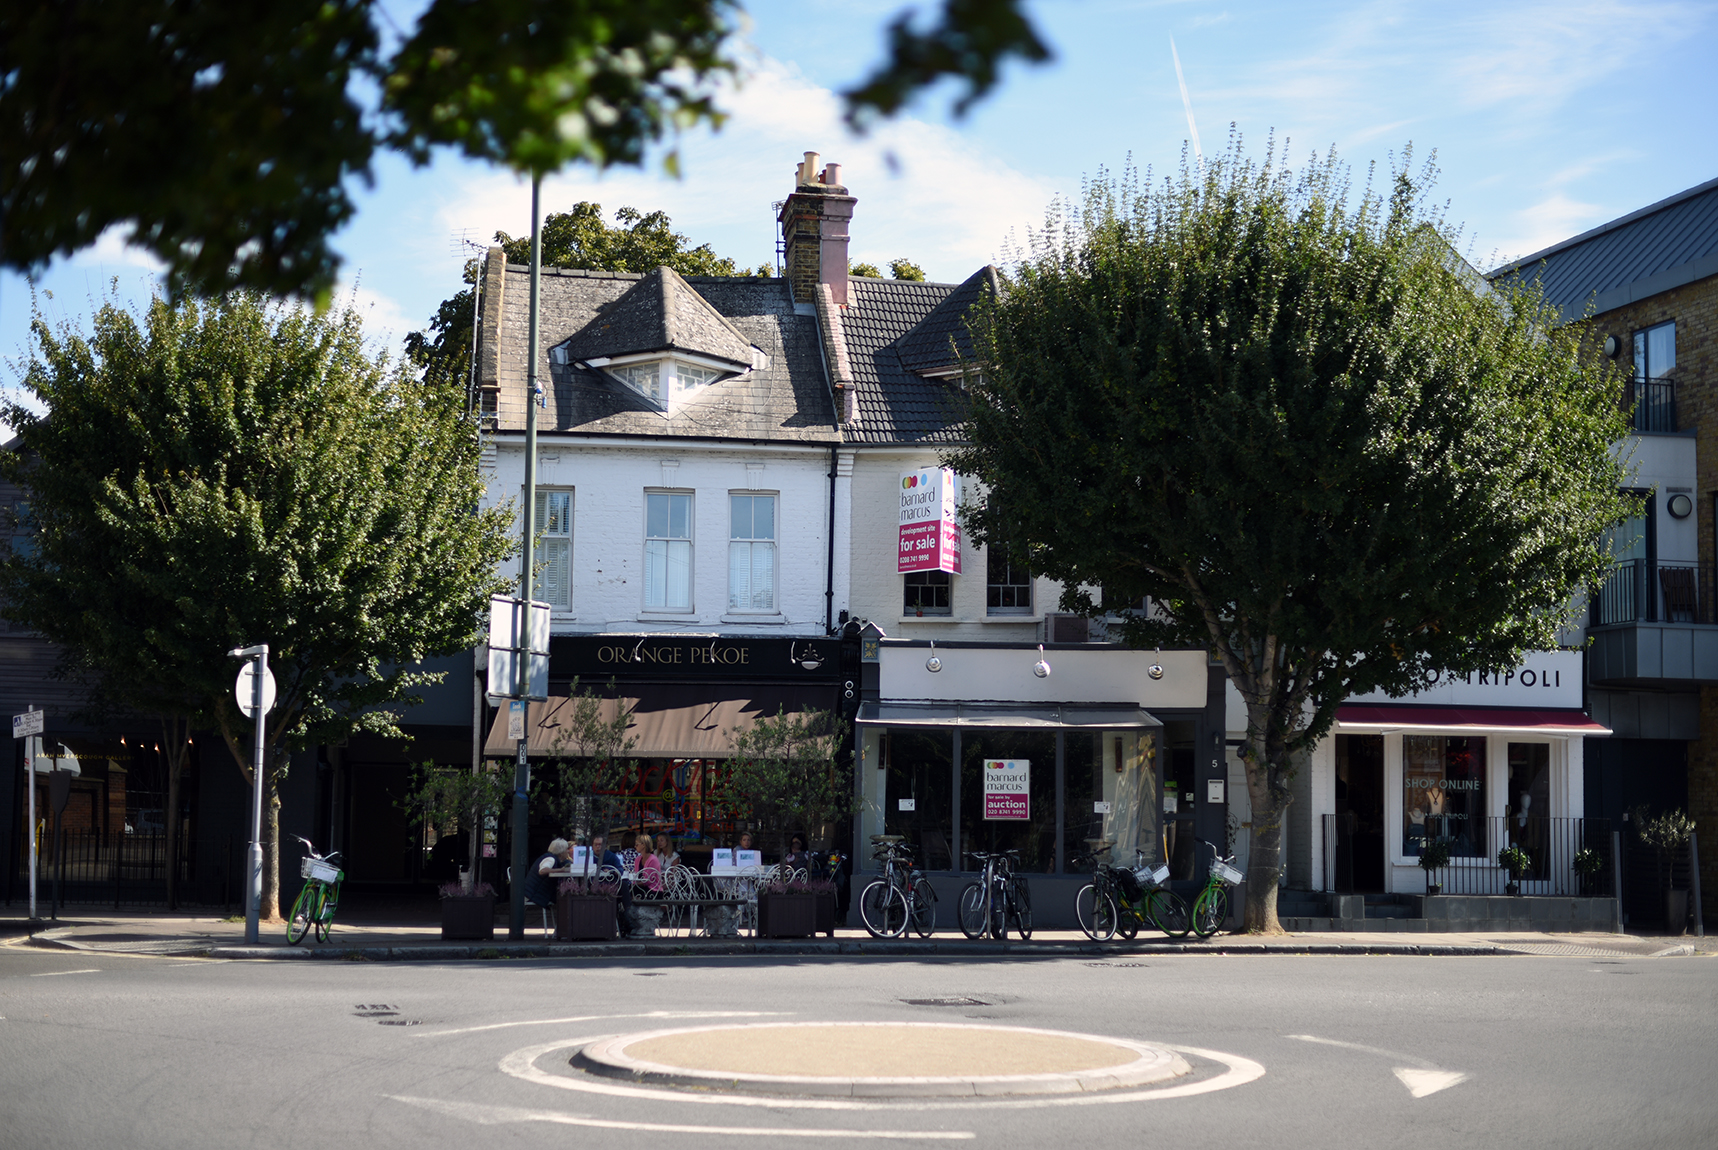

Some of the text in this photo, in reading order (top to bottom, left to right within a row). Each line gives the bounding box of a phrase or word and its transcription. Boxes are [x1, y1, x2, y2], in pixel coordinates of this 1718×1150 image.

[901, 487, 935, 507] barnard
[901, 506, 931, 521] marcus
[901, 526, 927, 536] development
[928, 524, 936, 532] site
[900, 534, 936, 552] for sale
[900, 556, 910, 564] 0208
[918, 553, 930, 562] 9990
[597, 645, 750, 664] ORANGE PEKOE
[1212, 759, 1218, 768] 5
[986, 772, 1027, 782] barnard
[986, 783, 1023, 791] marcus
[1405, 778, 1480, 790] SHOP ONLINE
[662, 789, 676, 802] @
[988, 800, 1026, 809] auction
